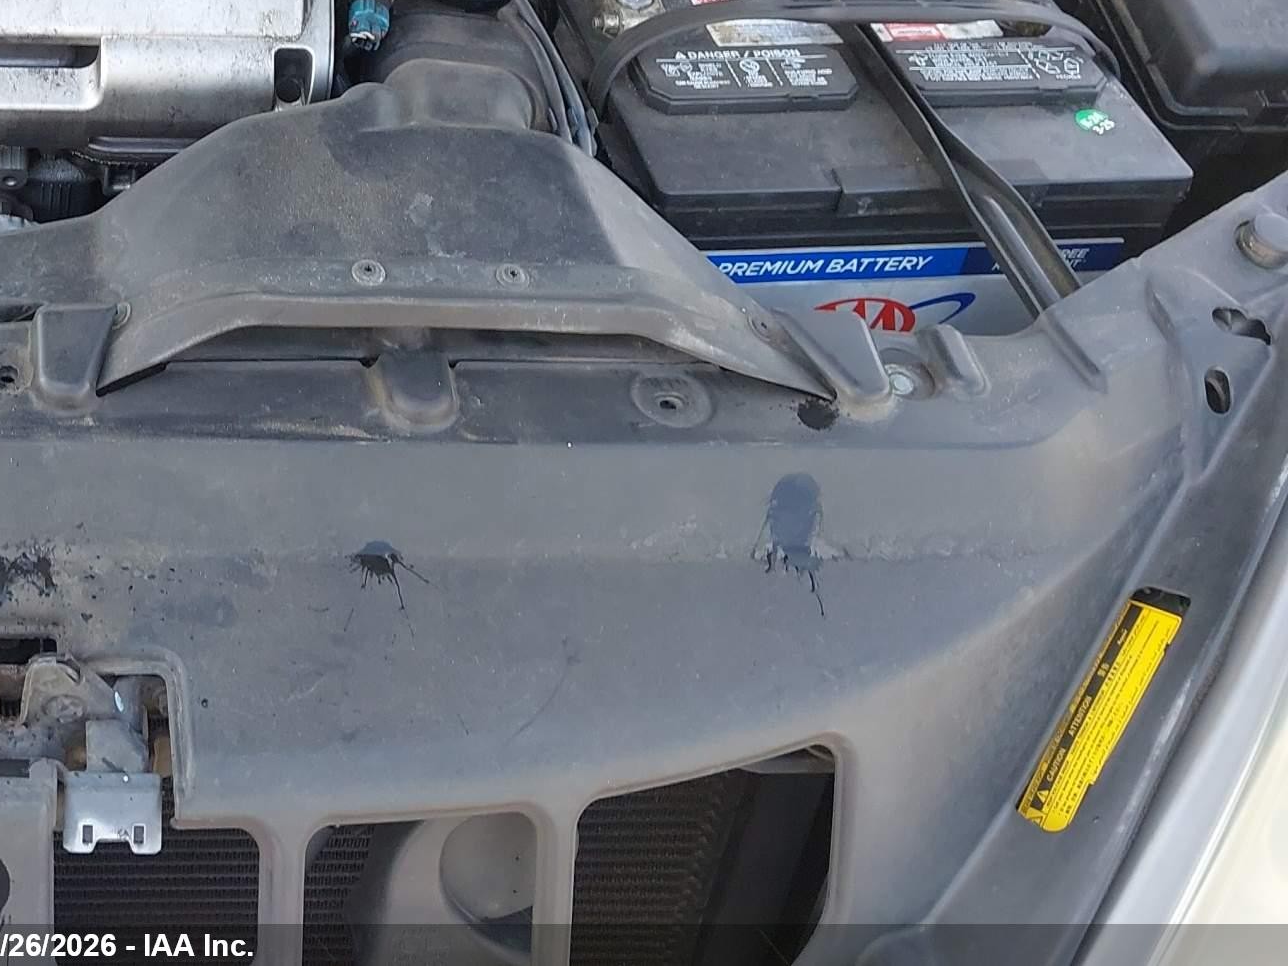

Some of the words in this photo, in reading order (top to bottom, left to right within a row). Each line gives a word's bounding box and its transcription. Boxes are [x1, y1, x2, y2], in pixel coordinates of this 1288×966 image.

[687, 50, 741, 60] DANGER
[753, 48, 801, 59] POISON
[716, 259, 824, 277] PREMIUM
[825, 256, 933, 273] BATTERY
[1068, 695, 1093, 738] ATTENTION
[1046, 747, 1066, 782] CAUTION
